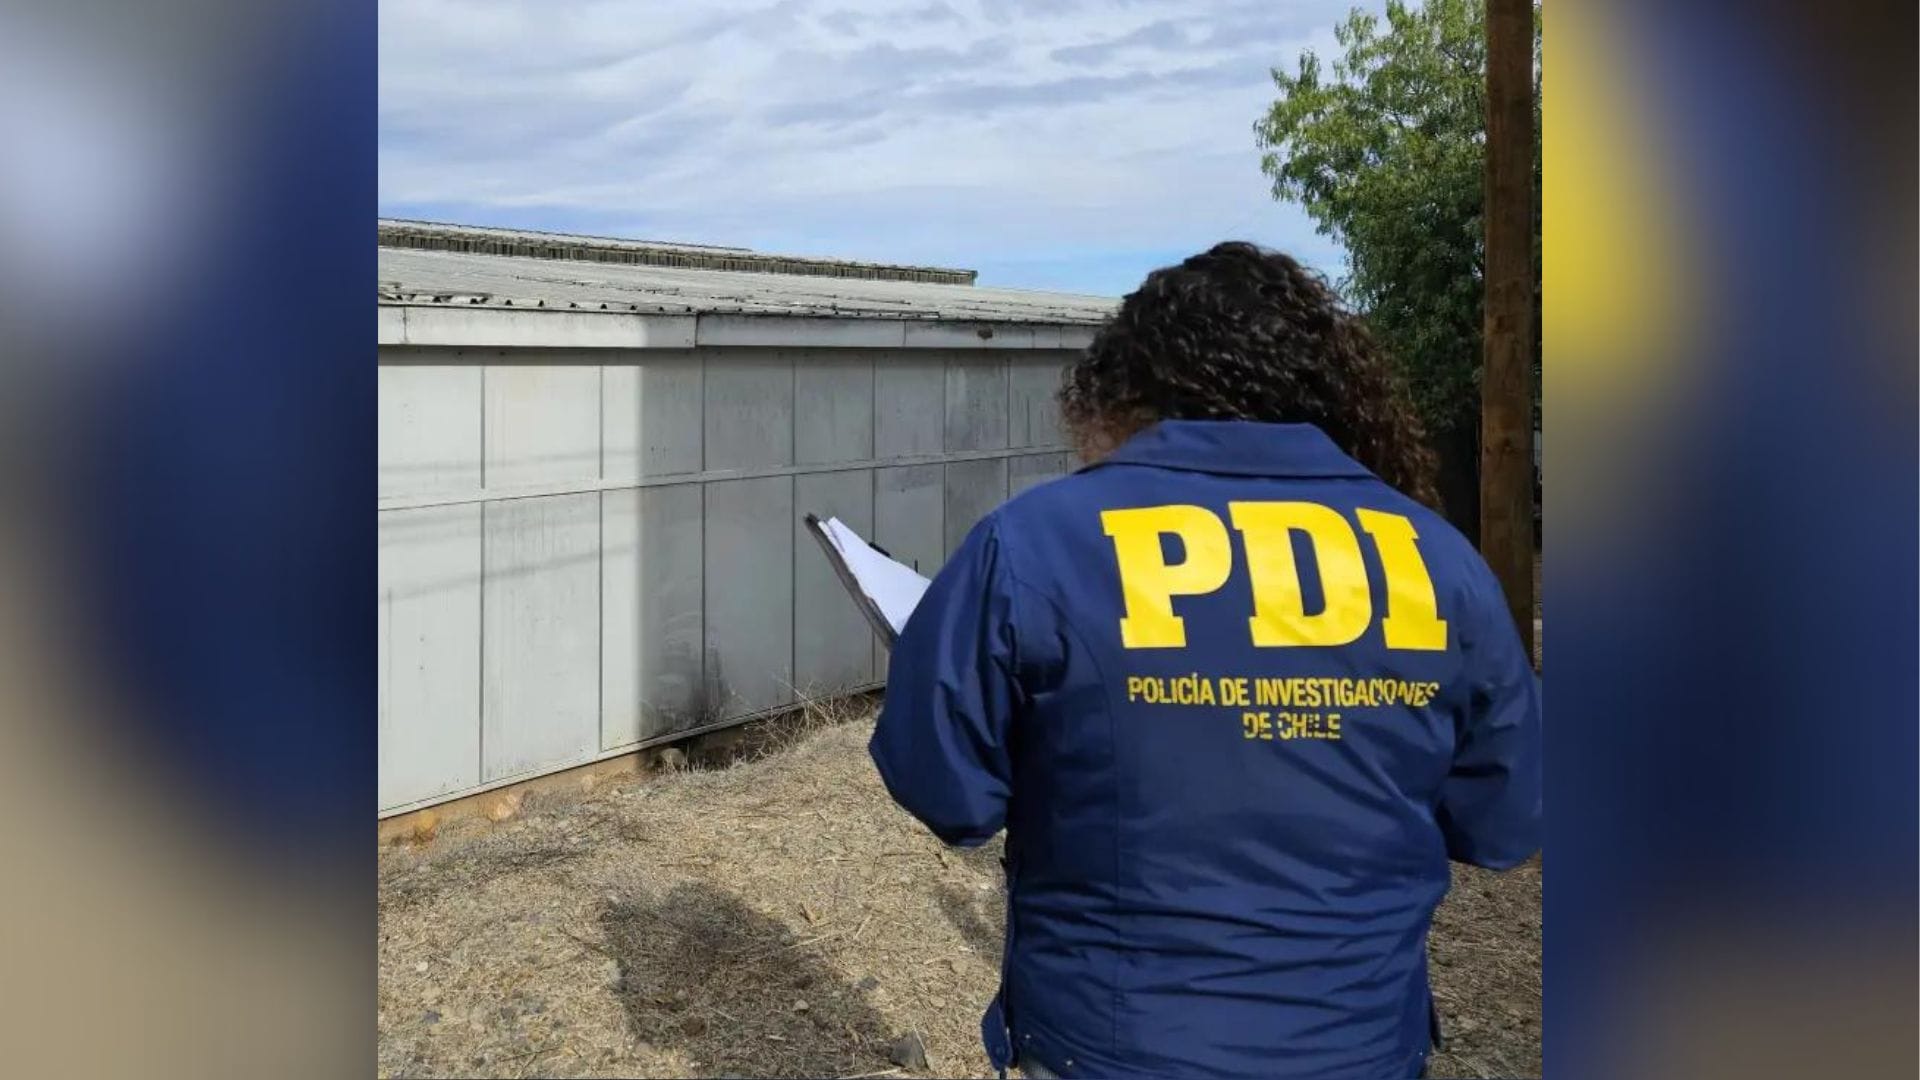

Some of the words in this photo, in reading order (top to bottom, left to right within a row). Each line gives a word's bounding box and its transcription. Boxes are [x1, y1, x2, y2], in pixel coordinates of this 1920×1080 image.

[1100, 501, 1448, 651] PDI
[1127, 672, 1216, 706] POLICÍA
[1219, 677, 1250, 707] DE
[1254, 677, 1440, 708] INVESTIGACIONES
[1242, 711, 1273, 740] DE
[1277, 711, 1342, 740] CHILE
